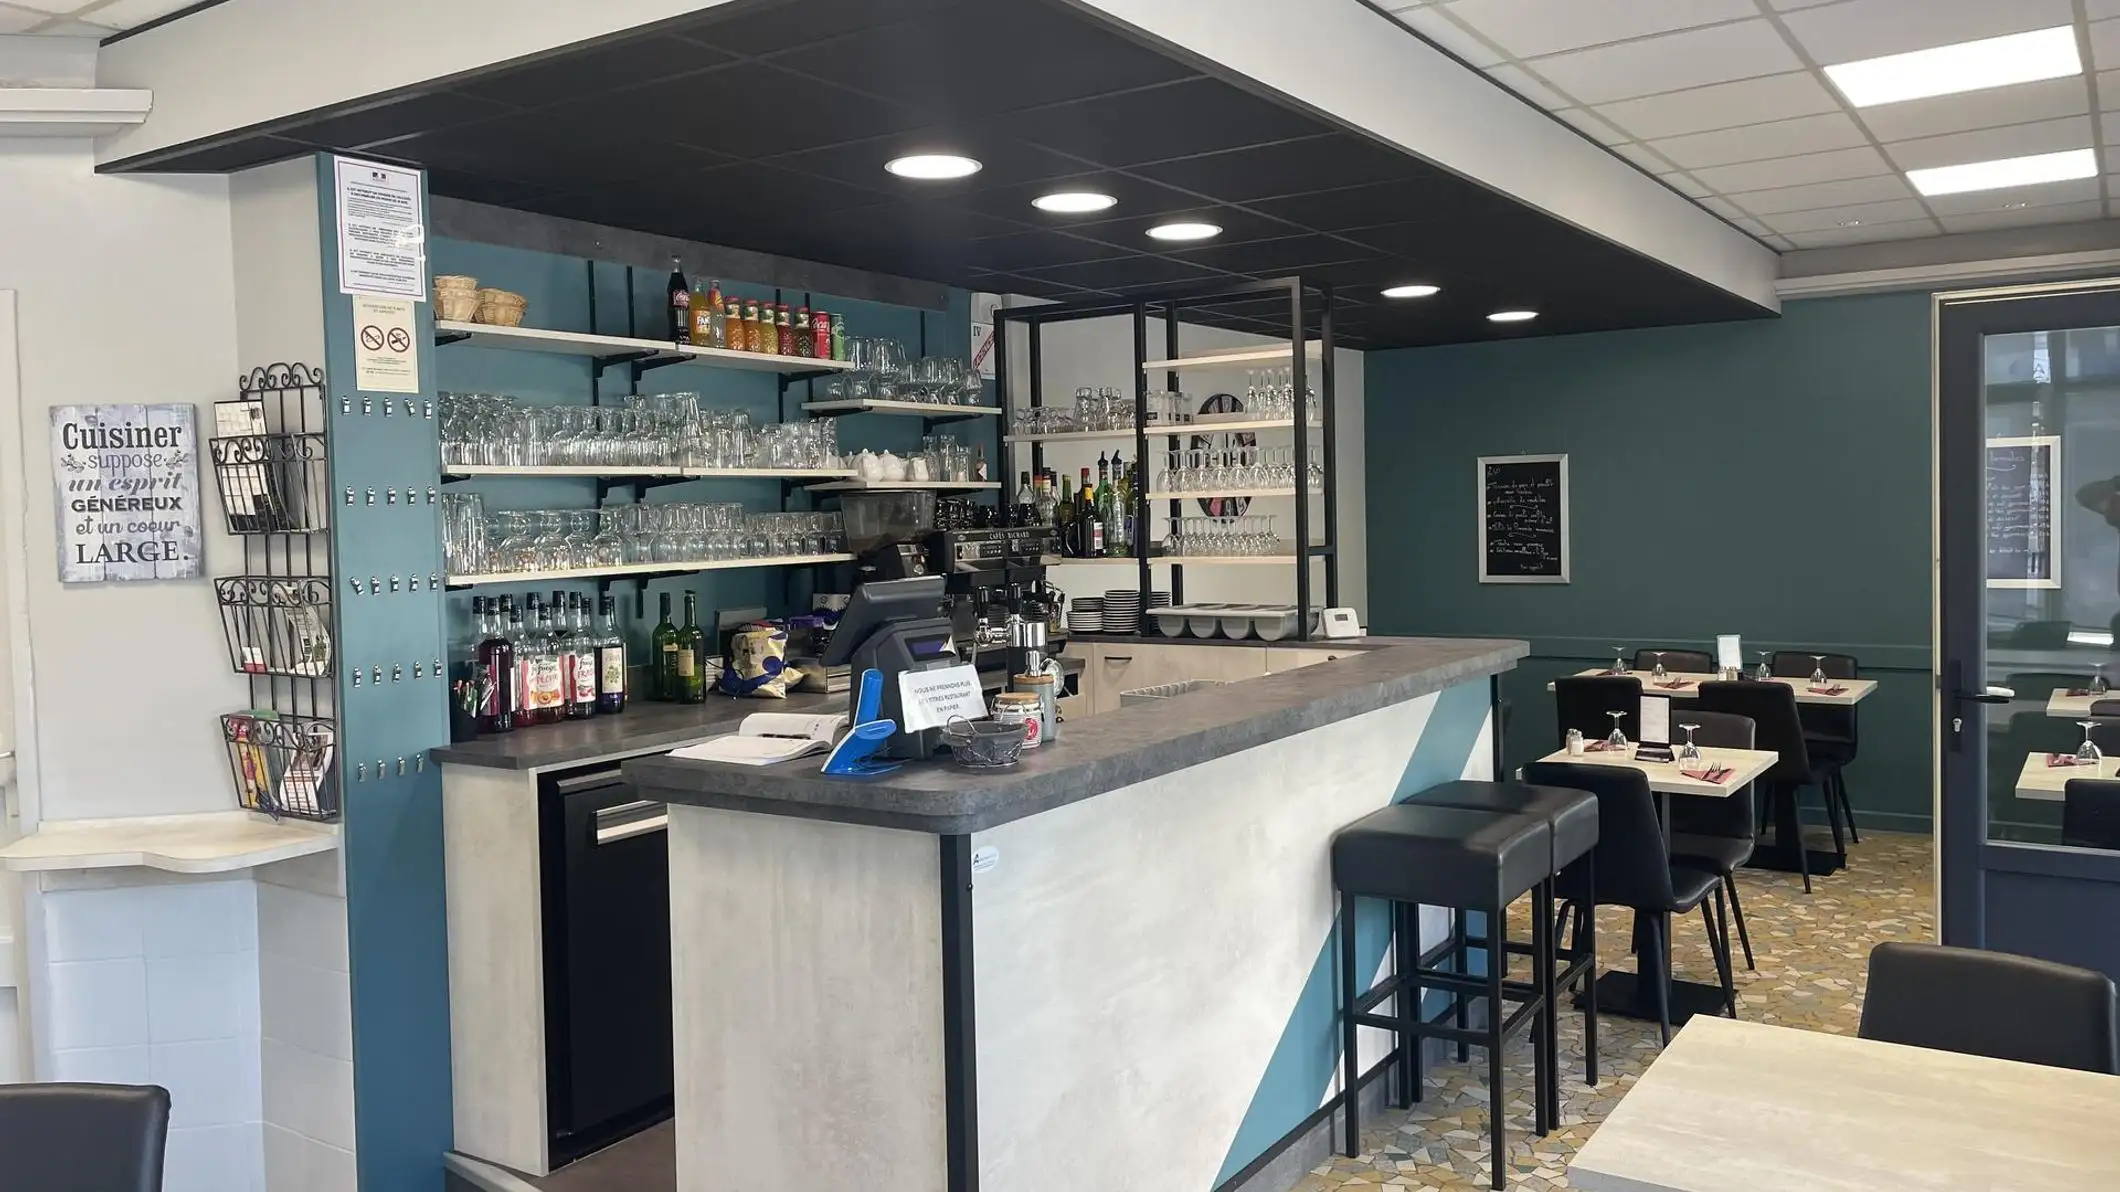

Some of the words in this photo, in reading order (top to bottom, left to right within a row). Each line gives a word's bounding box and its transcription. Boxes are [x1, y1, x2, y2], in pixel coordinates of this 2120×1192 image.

[63, 422, 182, 450] Cuisiner
[87, 453, 163, 477] suppose
[69, 478, 101, 492] un
[108, 471, 182, 496] esprit
[71, 495, 183, 513] GÉNÉREUX
[76, 516, 94, 535] et
[98, 522, 123, 534] un
[127, 520, 180, 533] coeur
[75, 540, 189, 564] LARGE.
